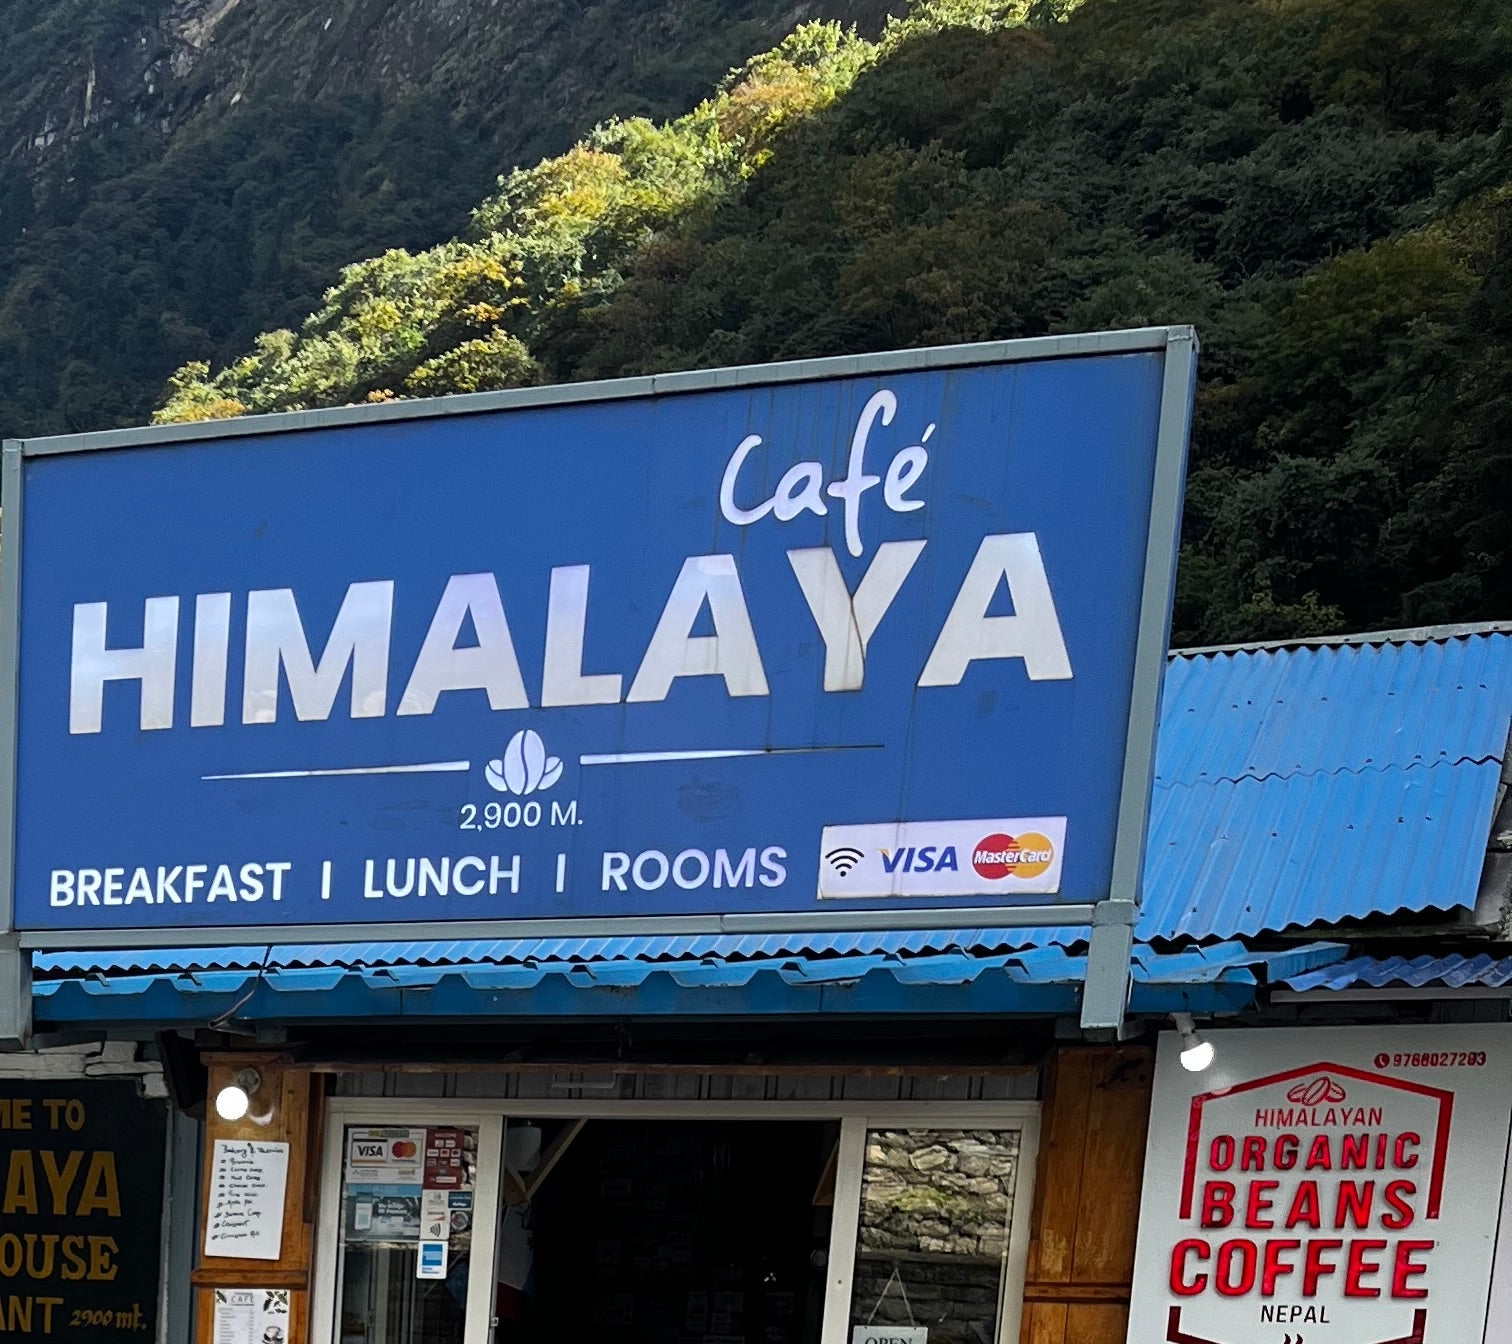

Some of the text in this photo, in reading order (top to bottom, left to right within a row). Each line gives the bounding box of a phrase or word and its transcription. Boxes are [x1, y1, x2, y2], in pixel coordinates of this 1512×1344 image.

[720, 389, 936, 557] Café
[69, 532, 1075, 735] HIMALAYA
[459, 800, 584, 833] 2,900 M.
[878, 846, 958, 873] VISA
[974, 848, 1051, 864] MasterCard
[50, 862, 291, 907] BREAKFAST
[364, 855, 520, 899] LUNCH
[601, 845, 787, 891] ROOMS
[43, 1099, 85, 1131] TO
[1254, 1106, 1383, 1128] HIMALAYAN
[357, 1146, 383, 1157] VISA
[1208, 1131, 1422, 1172] ORGANIC
[1200, 1179, 1418, 1230] BEANS
[1168, 1238, 1436, 1299] COFFEE
[68, 1309, 113, 1327] 2900
[1260, 1304, 1331, 1324] NEPAL
